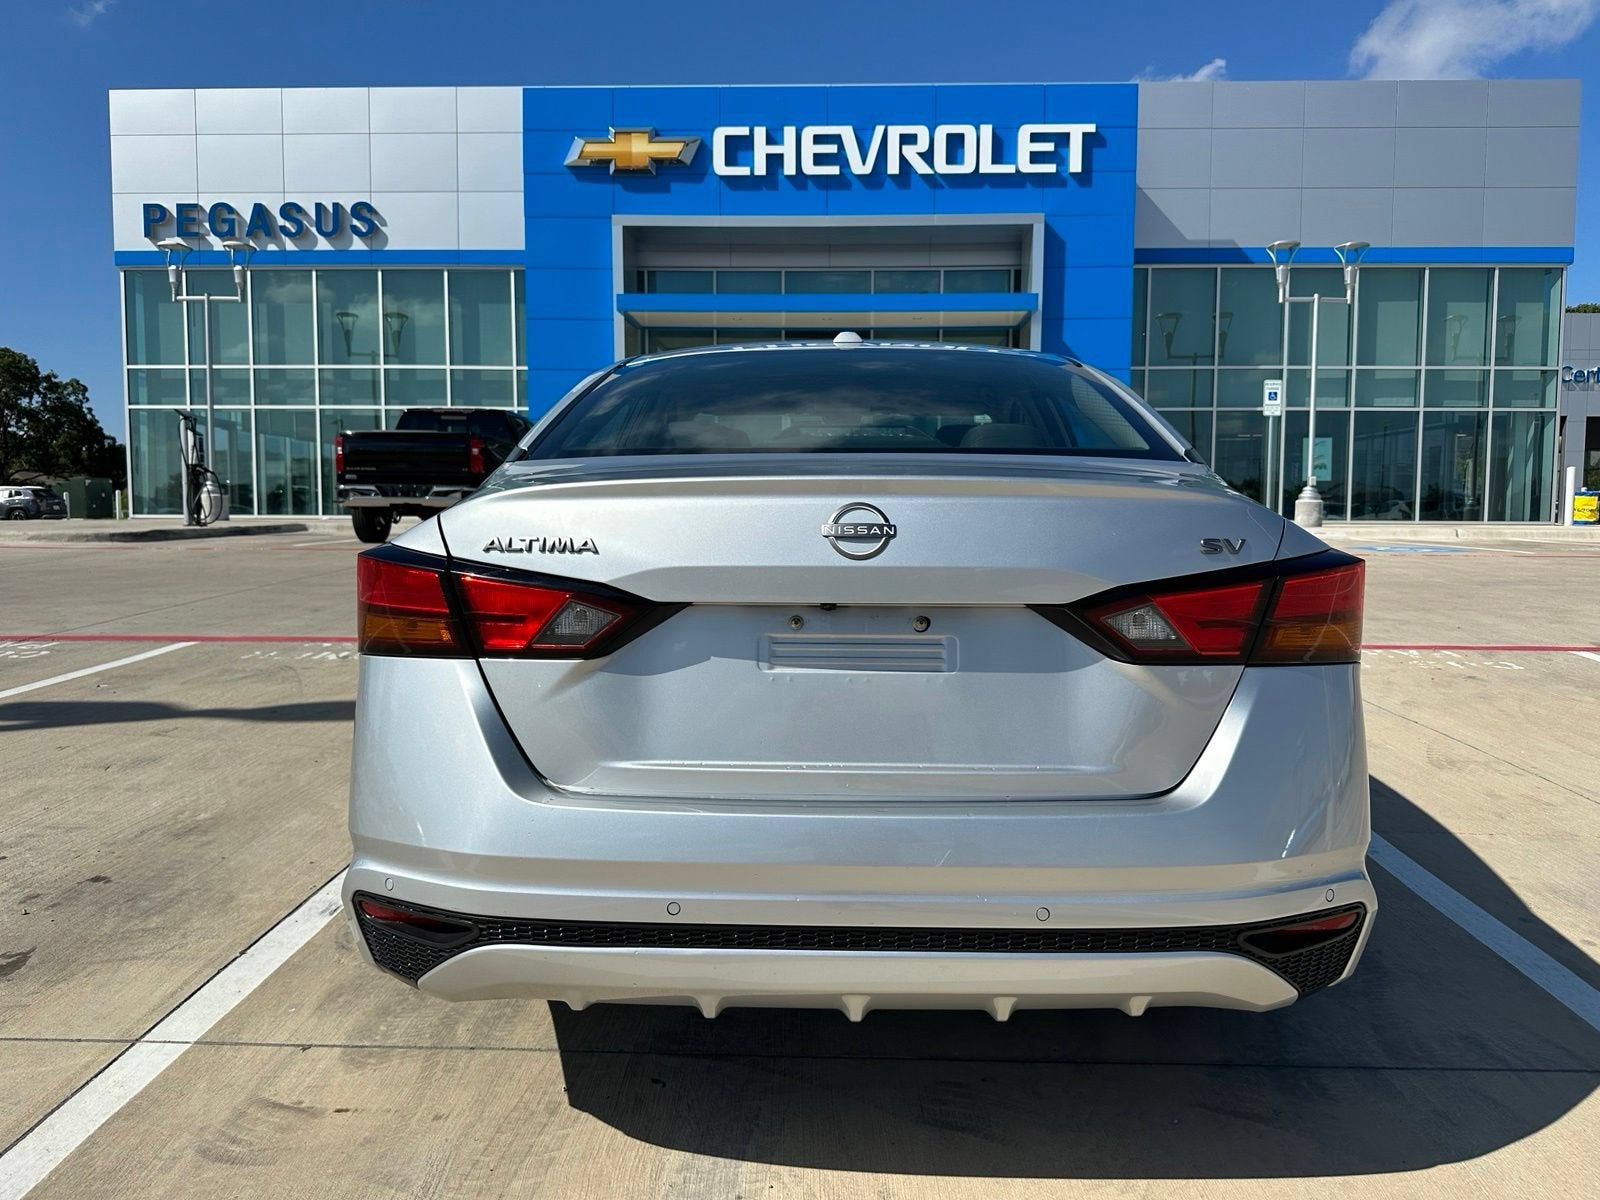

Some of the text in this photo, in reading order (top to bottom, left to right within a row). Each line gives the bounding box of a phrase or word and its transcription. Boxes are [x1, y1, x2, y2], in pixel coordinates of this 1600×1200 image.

[712, 124, 1097, 176] CHEVROLET
[143, 201, 375, 238] PEGASUS
[824, 525, 895, 535] NISSAN
[482, 536, 600, 555] ALTIMA
[1200, 538, 1246, 555] SV
